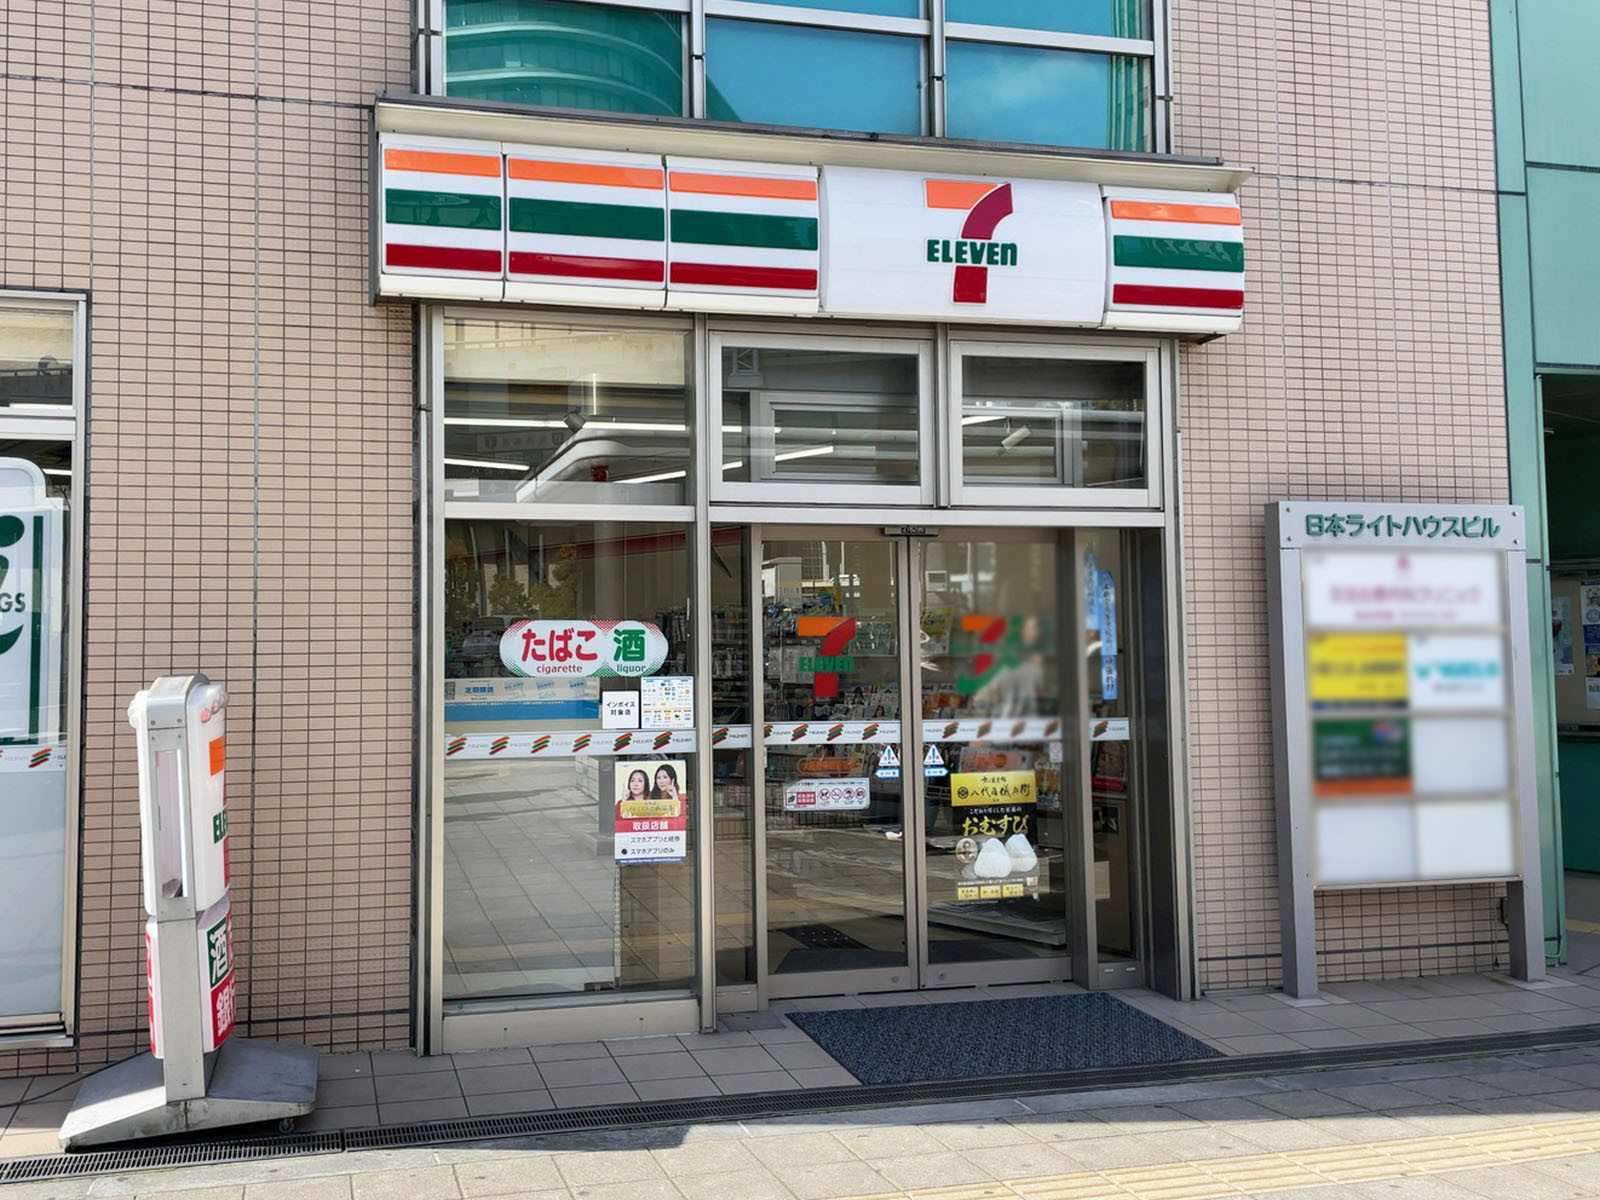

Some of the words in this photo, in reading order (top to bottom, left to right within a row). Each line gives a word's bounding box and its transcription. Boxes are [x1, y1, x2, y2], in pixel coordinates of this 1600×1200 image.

[1305, 513, 1501, 538] 日本ライトハウスビル
[521, 627, 598, 662] たばこ
[613, 628, 646, 662] 酒
[536, 664, 583, 674] cigarette
[616, 664, 647, 674] liquor
[962, 814, 1029, 837] おむすび
[209, 925, 227, 985] 酒
